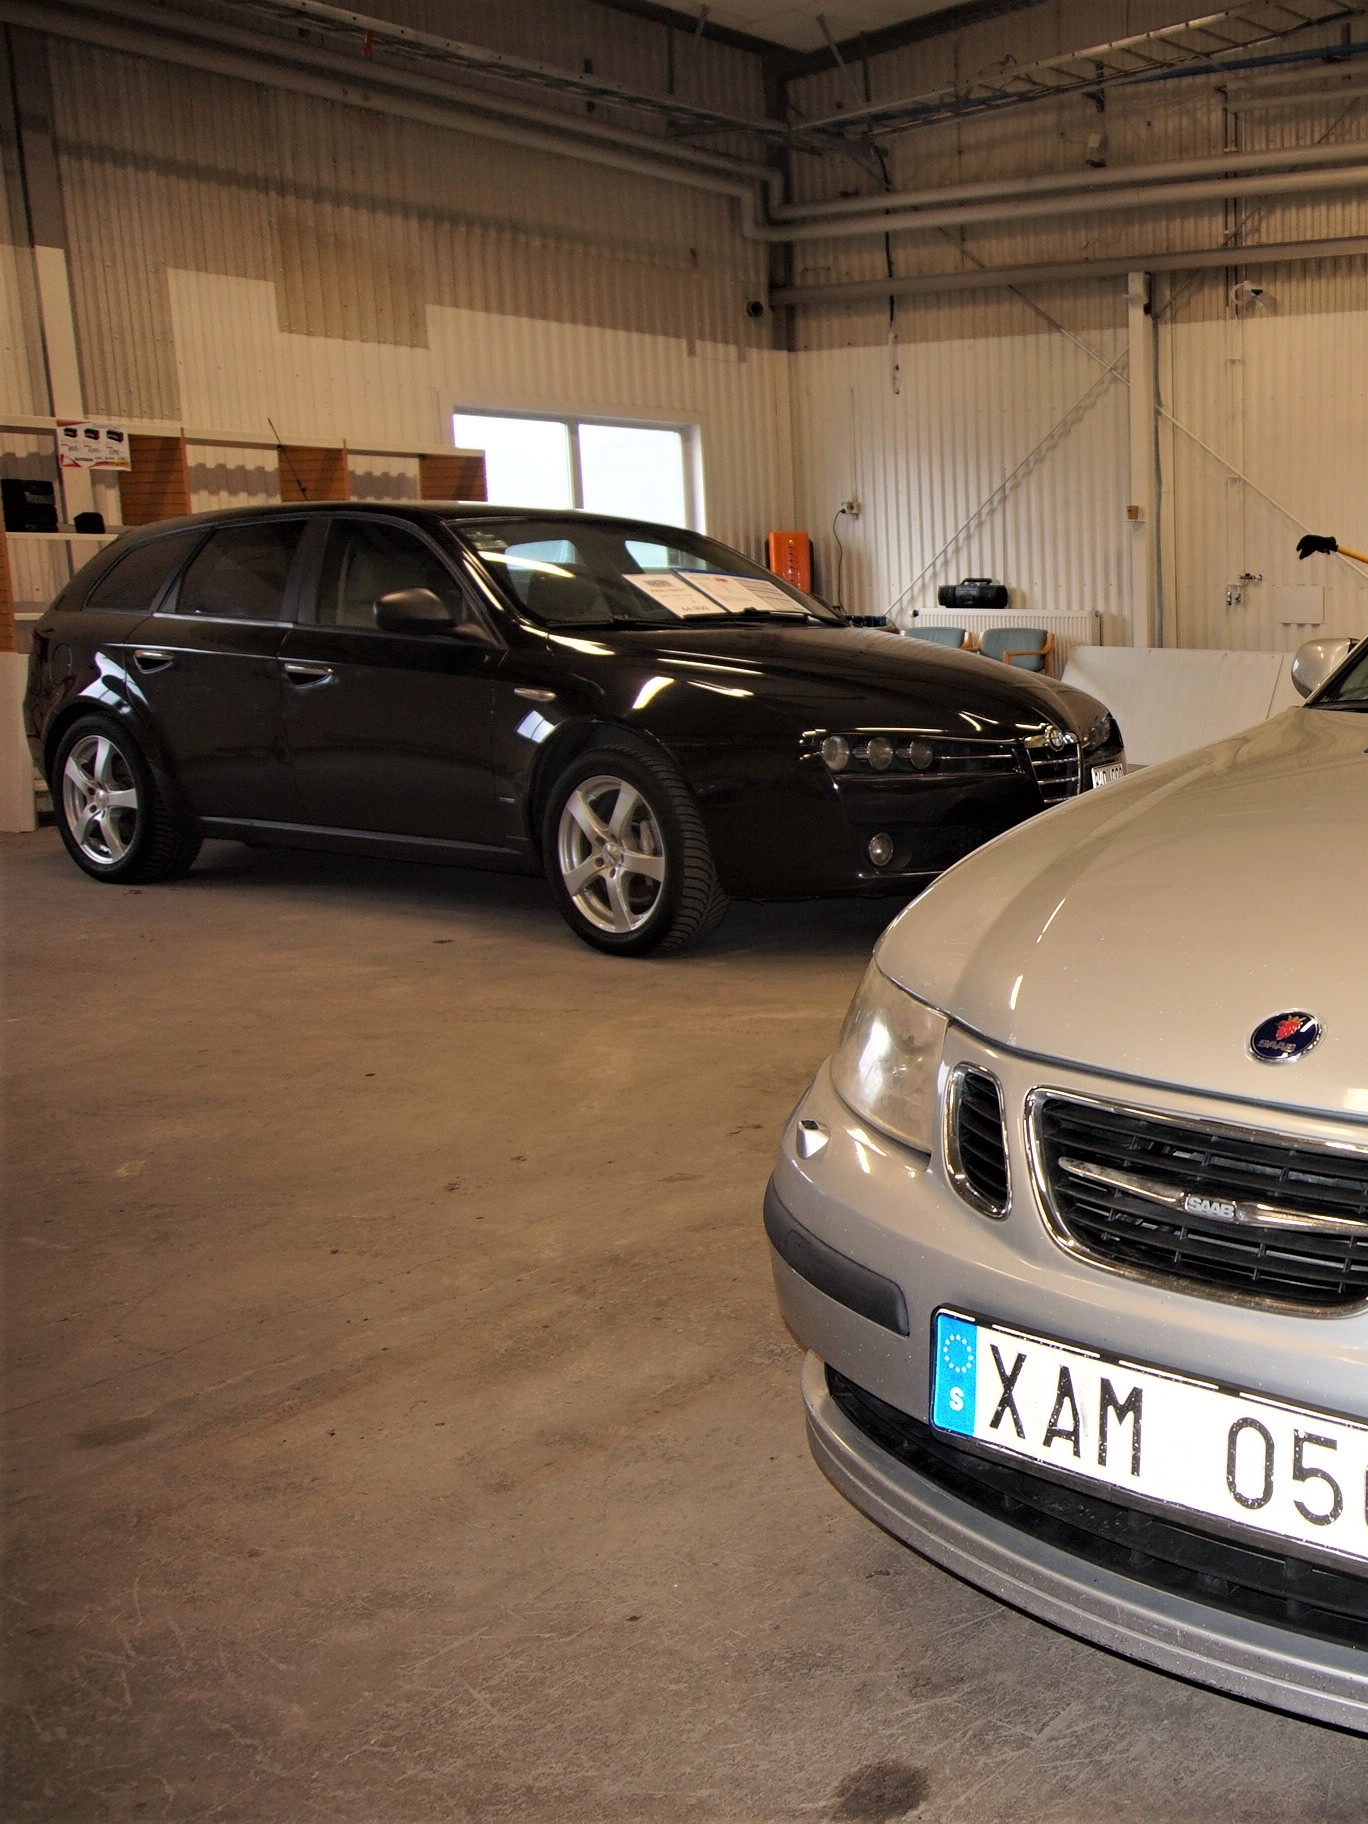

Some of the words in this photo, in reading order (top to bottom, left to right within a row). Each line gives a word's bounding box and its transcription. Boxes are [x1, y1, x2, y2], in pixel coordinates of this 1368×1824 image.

[1257, 1039, 1297, 1053] SAAB
[1188, 1196, 1235, 1219] SAAB
[949, 1386, 965, 1412] S
[989, 1344, 1144, 1477] XAM
